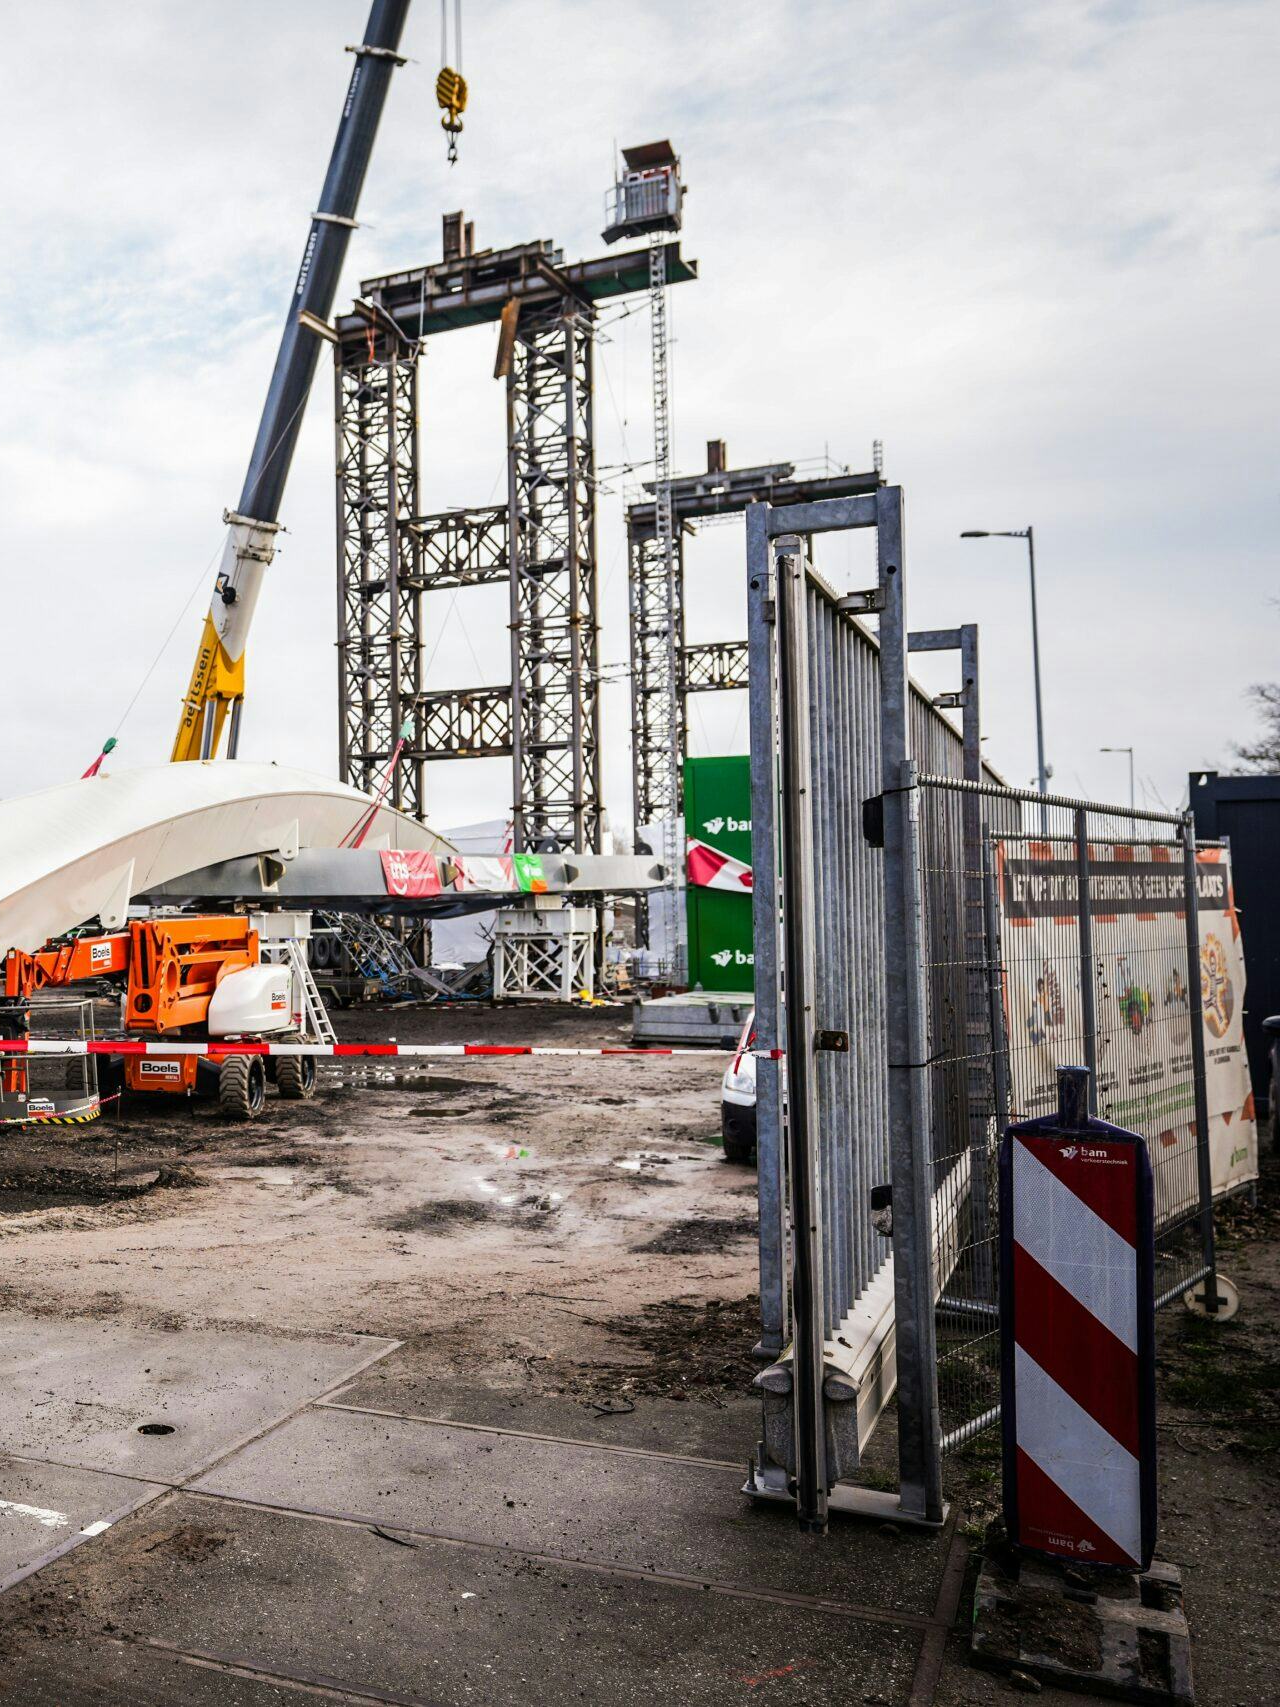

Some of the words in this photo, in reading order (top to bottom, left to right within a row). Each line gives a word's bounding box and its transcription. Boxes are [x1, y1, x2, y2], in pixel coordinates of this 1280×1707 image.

[727, 816, 752, 832] ba
[92, 946, 110, 958] Boels
[736, 949, 754, 965] ba
[142, 1063, 178, 1073] Boels
[1081, 1146, 1107, 1158] bam
[1048, 1537, 1074, 1551] bam
